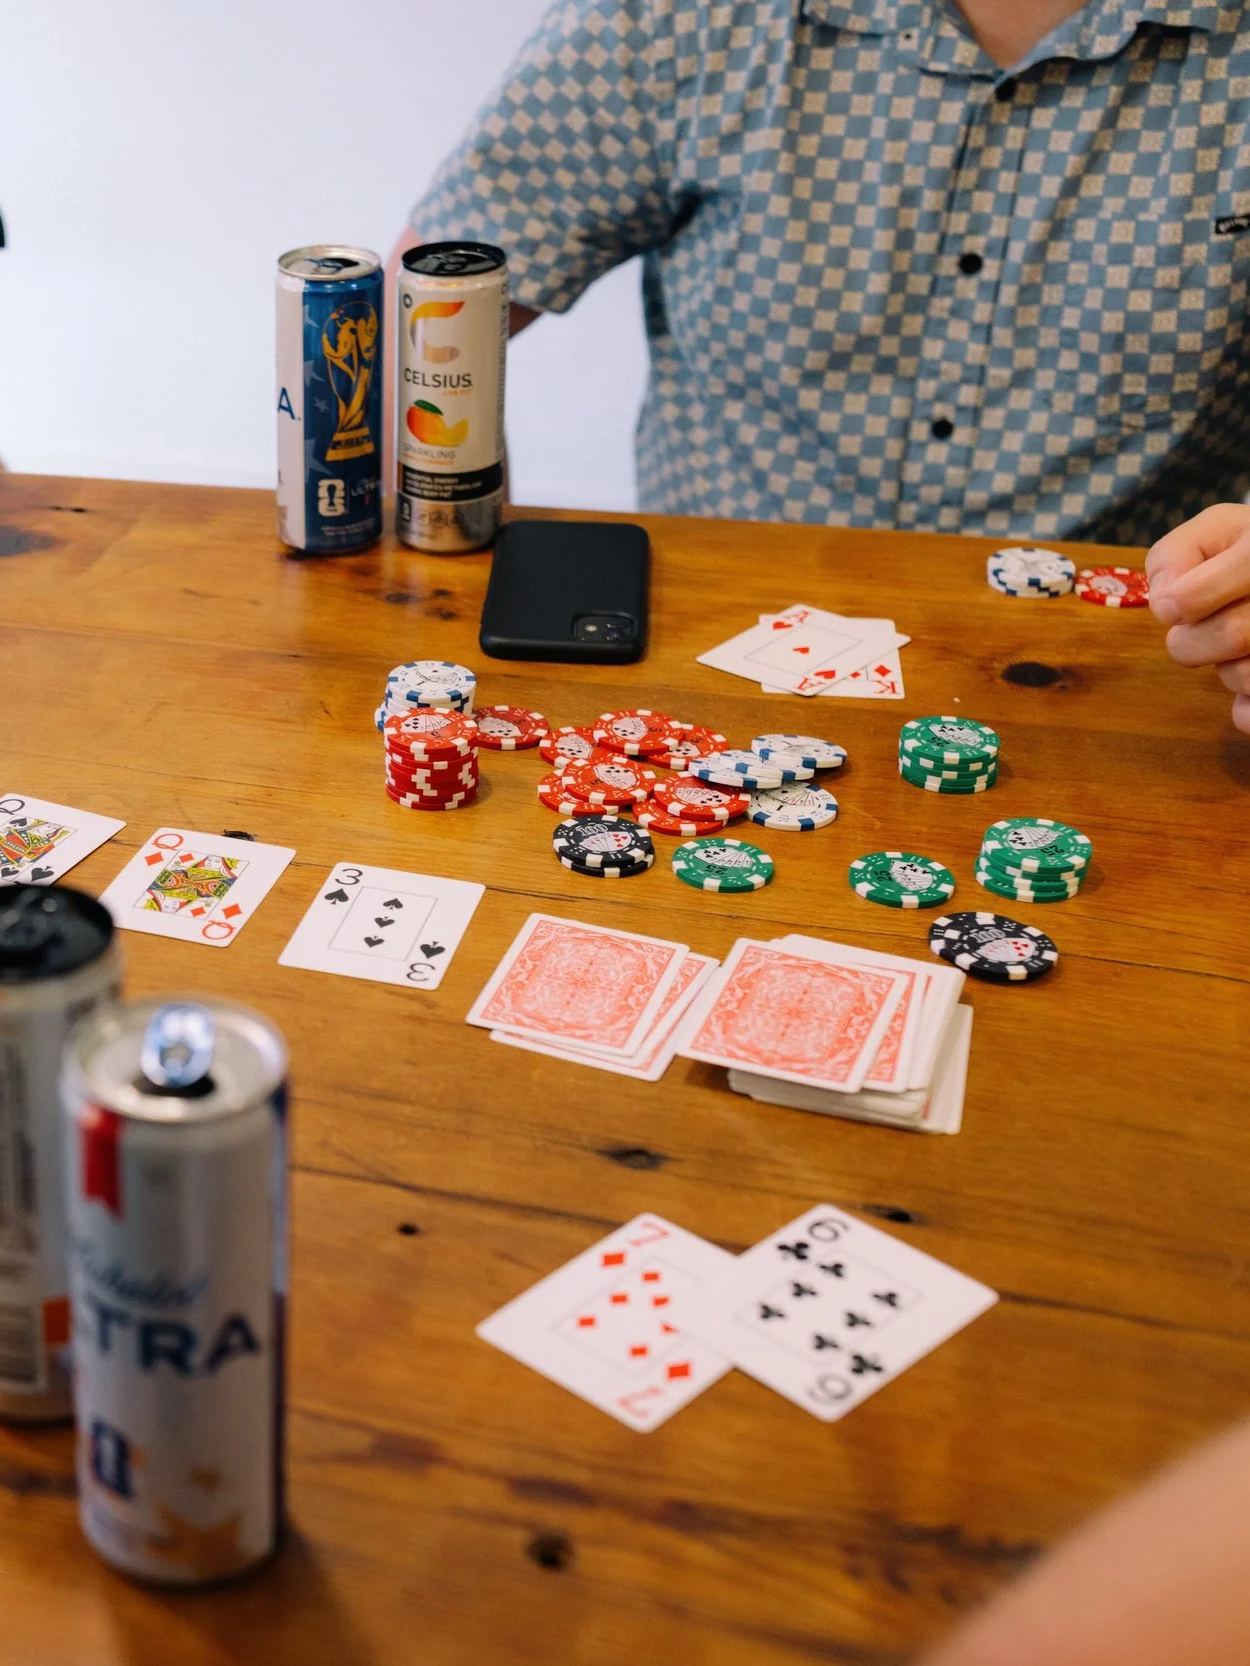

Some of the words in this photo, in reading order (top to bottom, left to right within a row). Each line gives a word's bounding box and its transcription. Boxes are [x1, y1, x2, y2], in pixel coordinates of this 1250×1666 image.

[404, 367, 472, 388] CELSIUS
[795, 677, 826, 691] A
[870, 679, 899, 695] K
[575, 823, 609, 837] 100
[150, 832, 184, 852] Q
[334, 868, 364, 886] 3
[704, 863, 729, 876] 25
[875, 869, 893, 882] 25
[202, 919, 237, 941] Q
[970, 928, 1007, 943] 100
[406, 962, 437, 982] 3
[629, 1220, 671, 1249] 7
[807, 1216, 850, 1244] 6
[616, 1386, 665, 1418] 7
